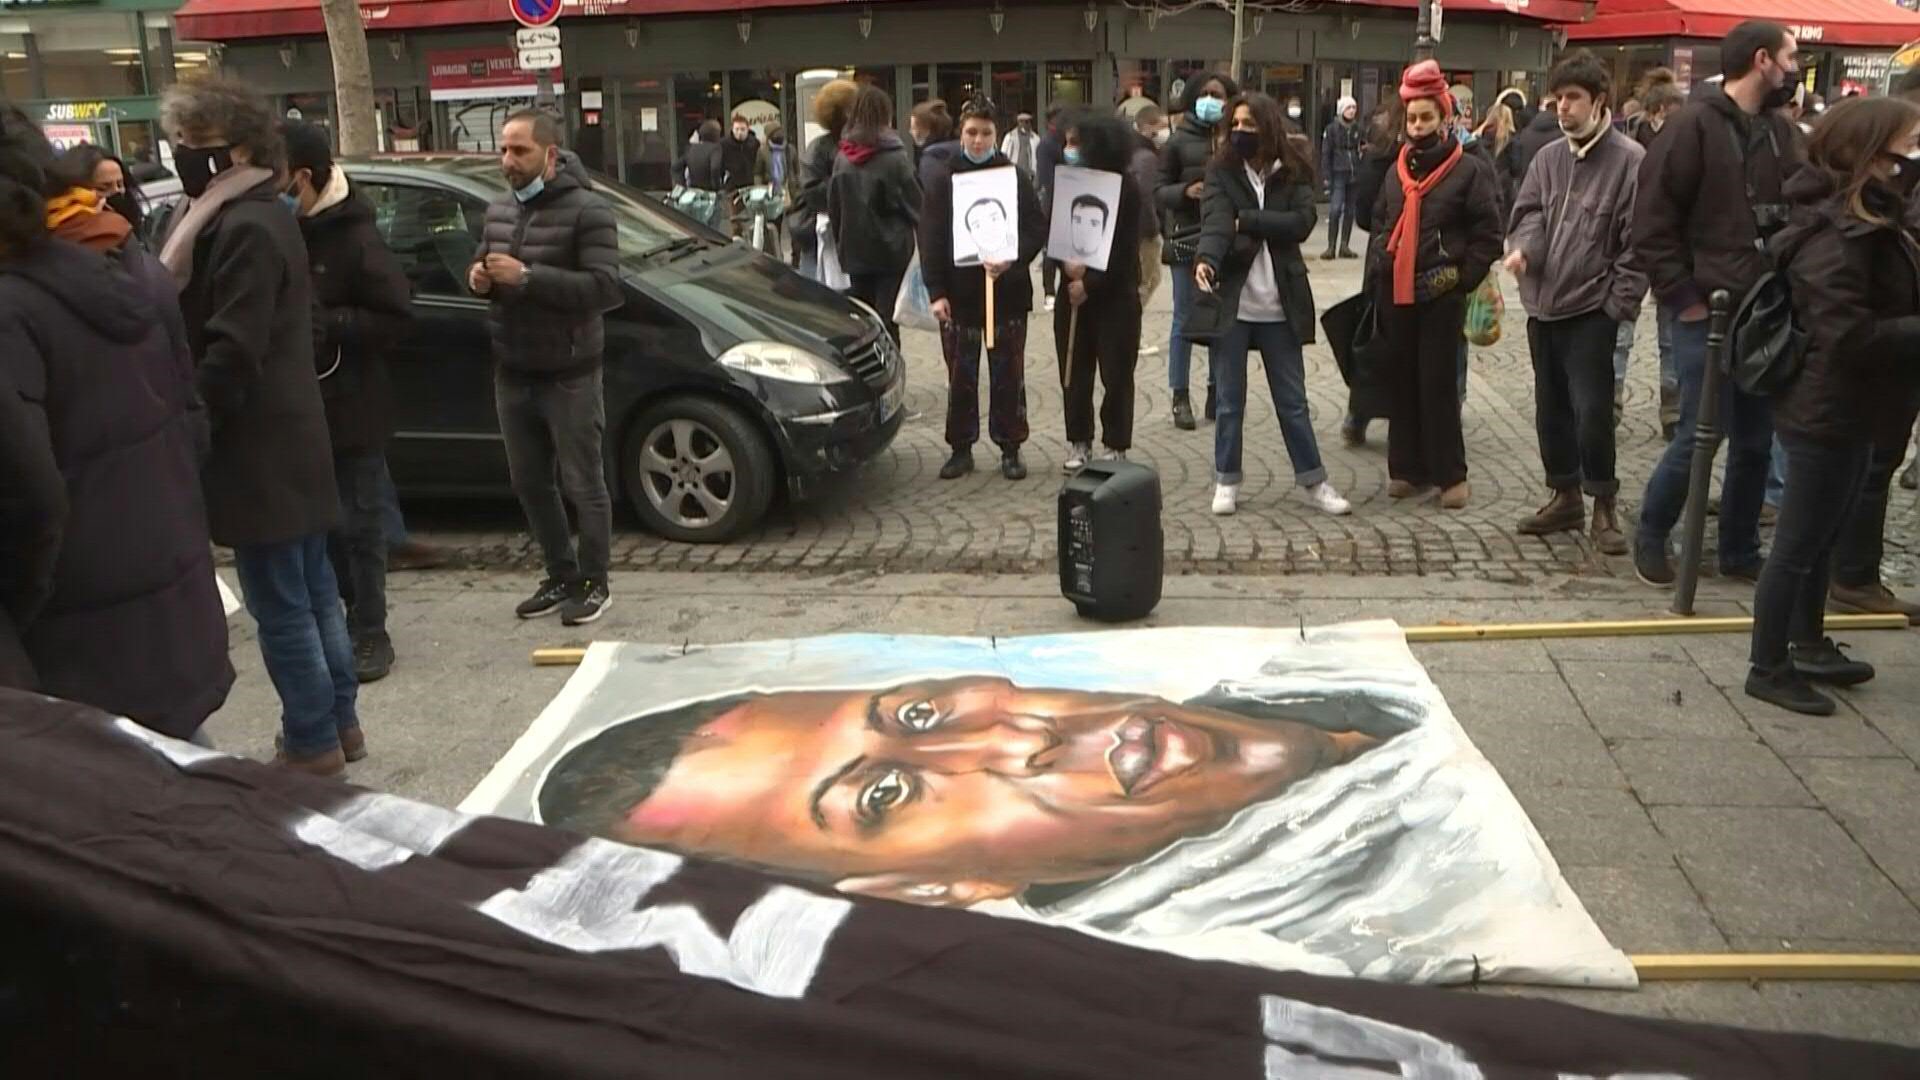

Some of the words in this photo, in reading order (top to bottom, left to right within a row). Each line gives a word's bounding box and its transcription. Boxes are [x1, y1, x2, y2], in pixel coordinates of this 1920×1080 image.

[1801, 25, 1822, 40] KING
[432, 64, 467, 75] LIVRAISON
[490, 57, 512, 71] VENTE
[1846, 68, 1865, 78] MAIS
[1865, 68, 1880, 79] PAS
[47, 102, 106, 120] SUBWAY
